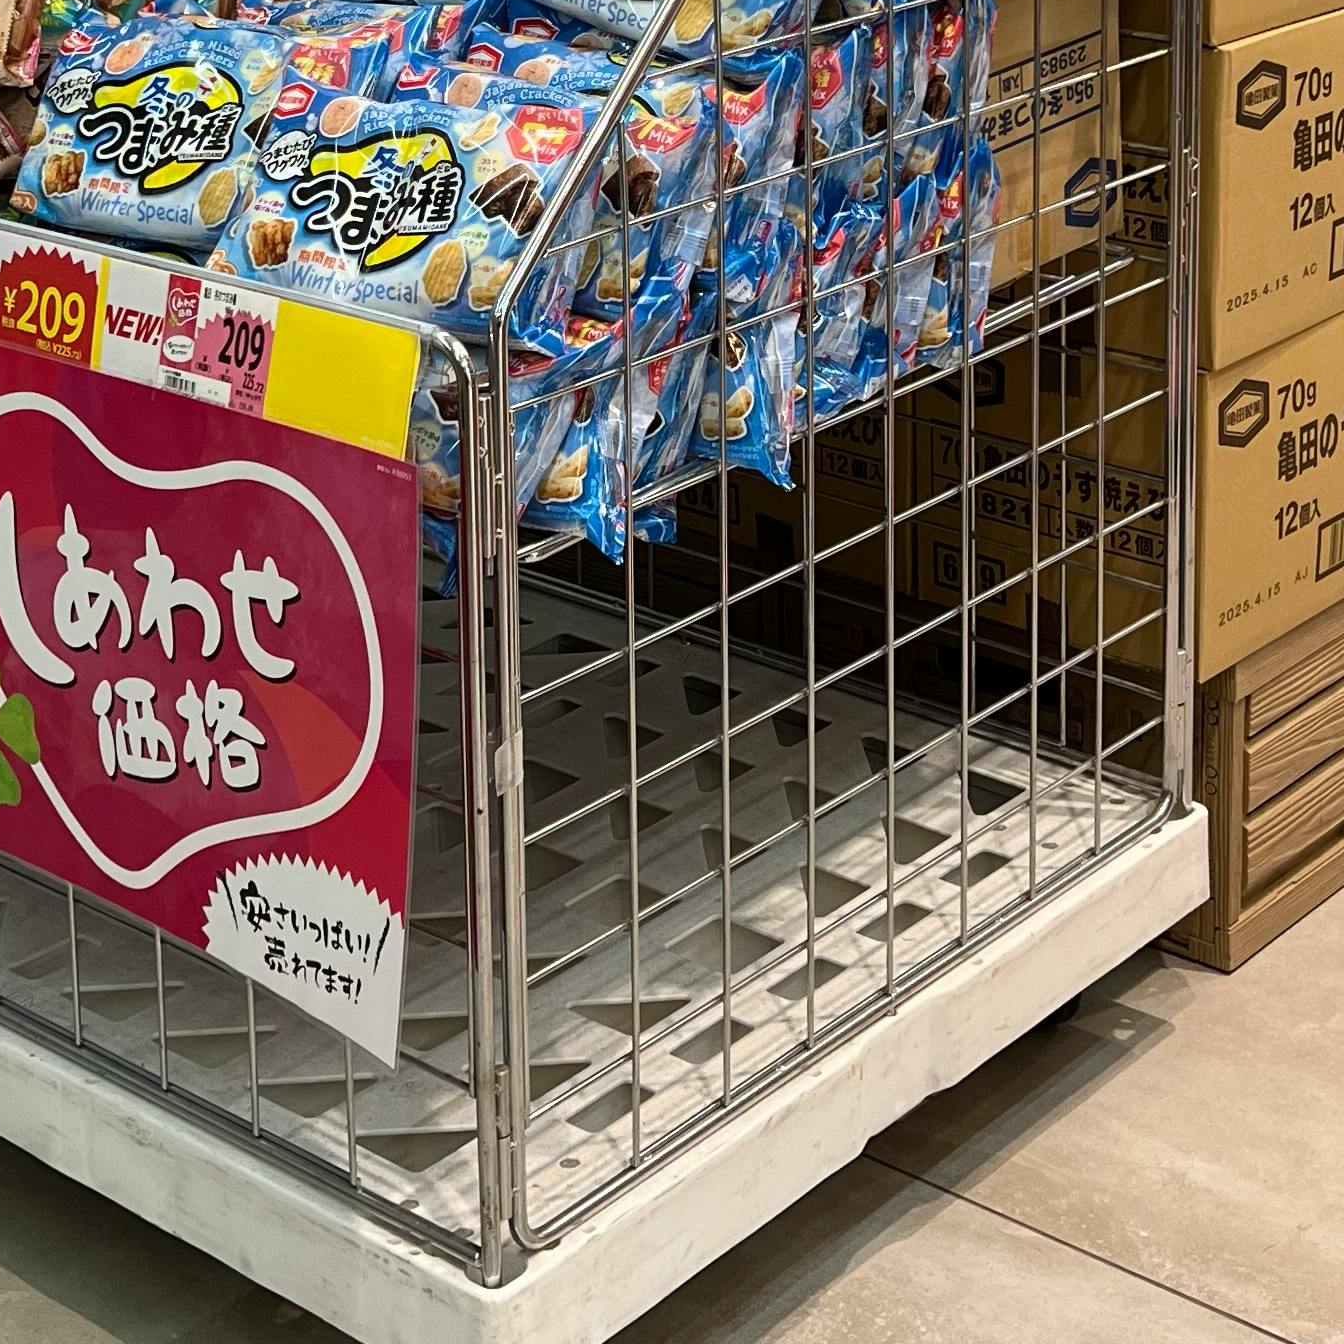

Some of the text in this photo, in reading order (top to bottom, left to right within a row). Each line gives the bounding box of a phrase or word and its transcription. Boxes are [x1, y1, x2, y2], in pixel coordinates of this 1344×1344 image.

[1039, 45, 1087, 76] 23983
[140, 76, 194, 115] 冬の
[1294, 66, 1333, 108] 70g
[80, 106, 242, 174] つまみ種
[81, 188, 194, 226] Winter Special
[293, 168, 462, 250] つまみ種
[1289, 191, 1336, 233] 12個入
[355, 274, 419, 305] Special
[1226, 274, 1290, 314] 2025.4.15
[4, 279, 86, 345] ¥209
[104, 302, 164, 346] NEW!
[218, 317, 265, 371] 209
[1276, 375, 1318, 417] 70g
[1274, 496, 1322, 541] 12個入
[1218, 567, 1309, 629] 2025.4.15 AJ
[91, 676, 267, 790] 価格
